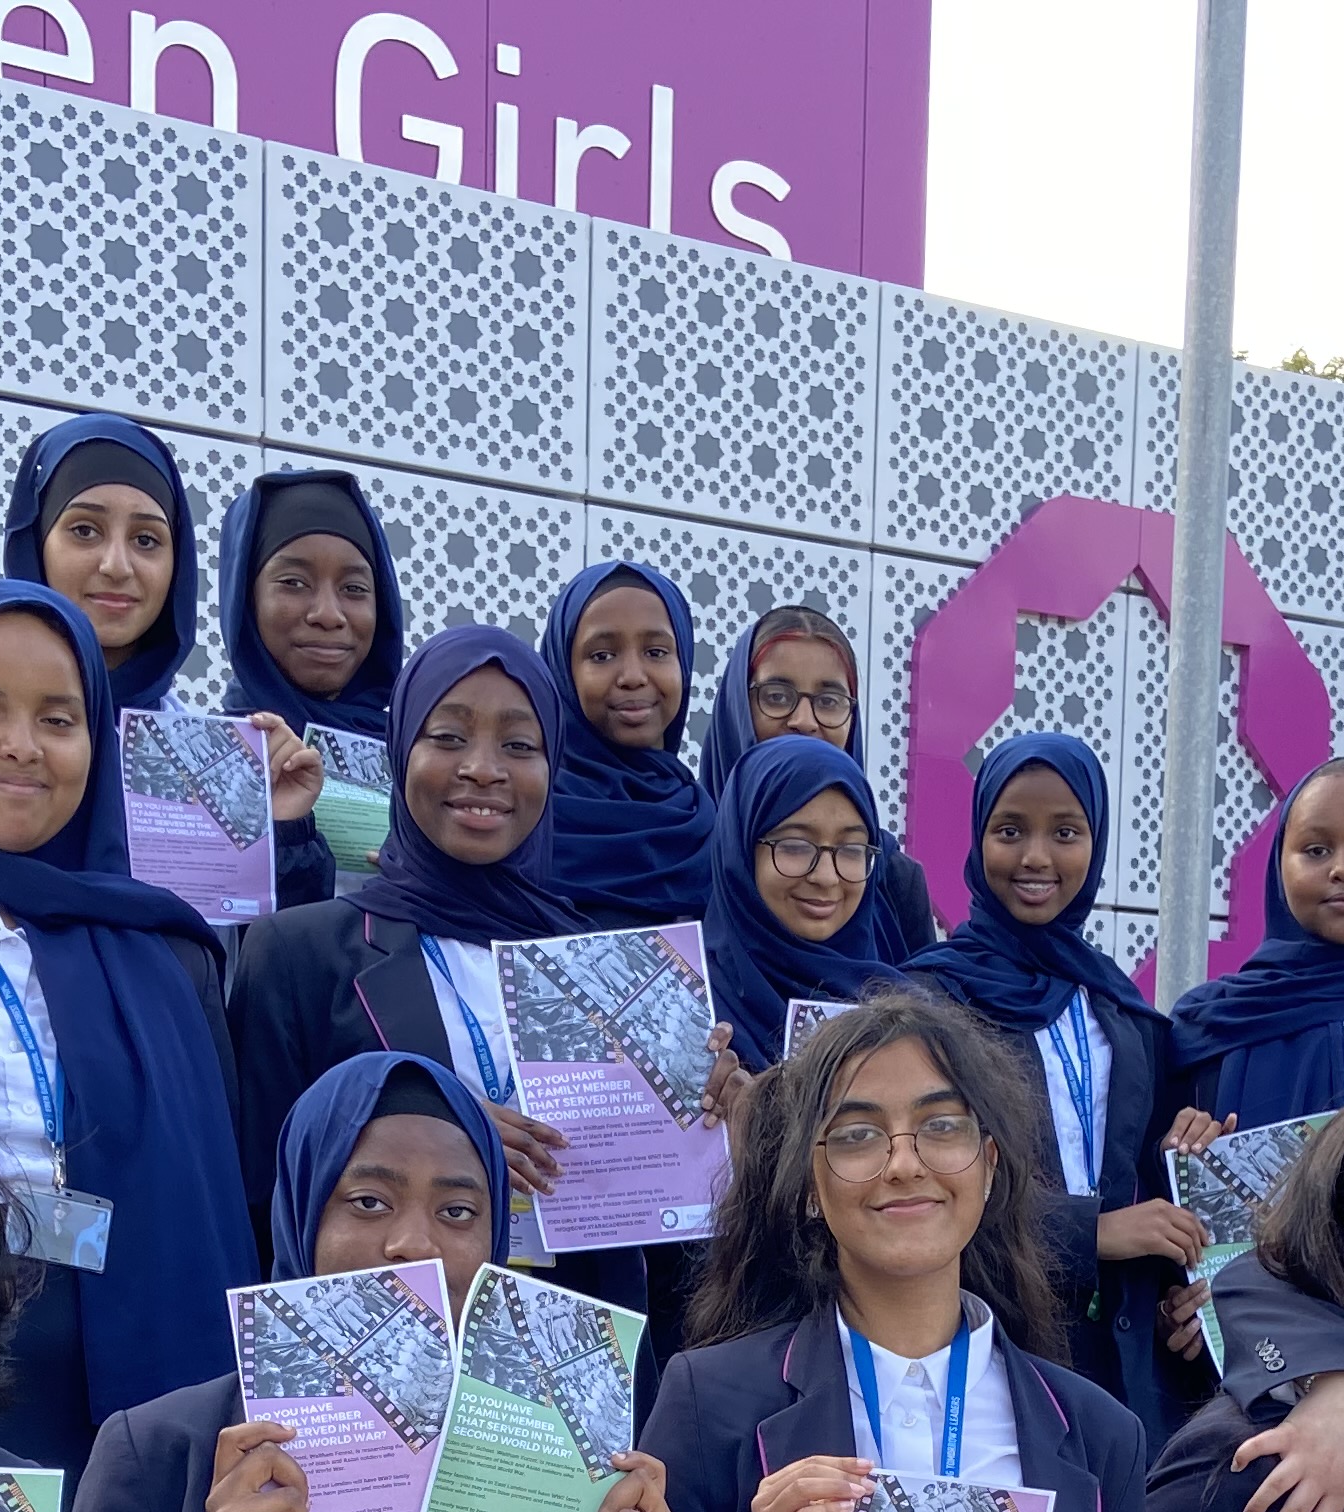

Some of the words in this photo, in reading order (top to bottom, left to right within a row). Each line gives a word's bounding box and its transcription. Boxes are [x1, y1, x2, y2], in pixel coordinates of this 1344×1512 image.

[334, 11, 793, 260] Girls
[523, 1078, 541, 1088] DO
[543, 1074, 569, 1085] YOU
[571, 1070, 605, 1082] HAVE
[527, 1090, 536, 1099] A
[538, 1084, 580, 1098] FAMILY
[583, 1080, 631, 1092] MEMBER
[528, 1098, 560, 1111] THAT
[563, 1093, 607, 1107] SERVED
[610, 1093, 620, 1103] IN
[623, 1092, 644, 1102] THE
[531, 1110, 580, 1122] SECOND
[581, 1106, 621, 1118] WORLD
[623, 1104, 655, 1115] WAR?
[1208, 1254, 1230, 1265] YOU
[273, 1408, 298, 1418] YOU
[301, 1403, 333, 1414] HAVE
[461, 1392, 477, 1403] DO
[480, 1396, 502, 1408] YOU
[504, 1402, 533, 1416] HAVE
[281, 1417, 310, 1426] MILY
[311, 1410, 361, 1424] MEMBER
[458, 1404, 466, 1413] A
[468, 1406, 508, 1421] FAMILY
[510, 1415, 554, 1432] MEMBER
[298, 1425, 336, 1437] ERVED
[339, 1423, 350, 1433] IN
[353, 1421, 375, 1430] THE
[456, 1415, 486, 1428] THAT
[487, 1421, 529, 1437] SERVED
[531, 1431, 542, 1440] IN
[545, 1434, 564, 1446] THE
[309, 1435, 351, 1447] WORLD
[353, 1431, 386, 1441] WAR?
[453, 1426, 498, 1442] SECOND
[501, 1437, 540, 1452] WORLD
[542, 1445, 572, 1459] WAR?
